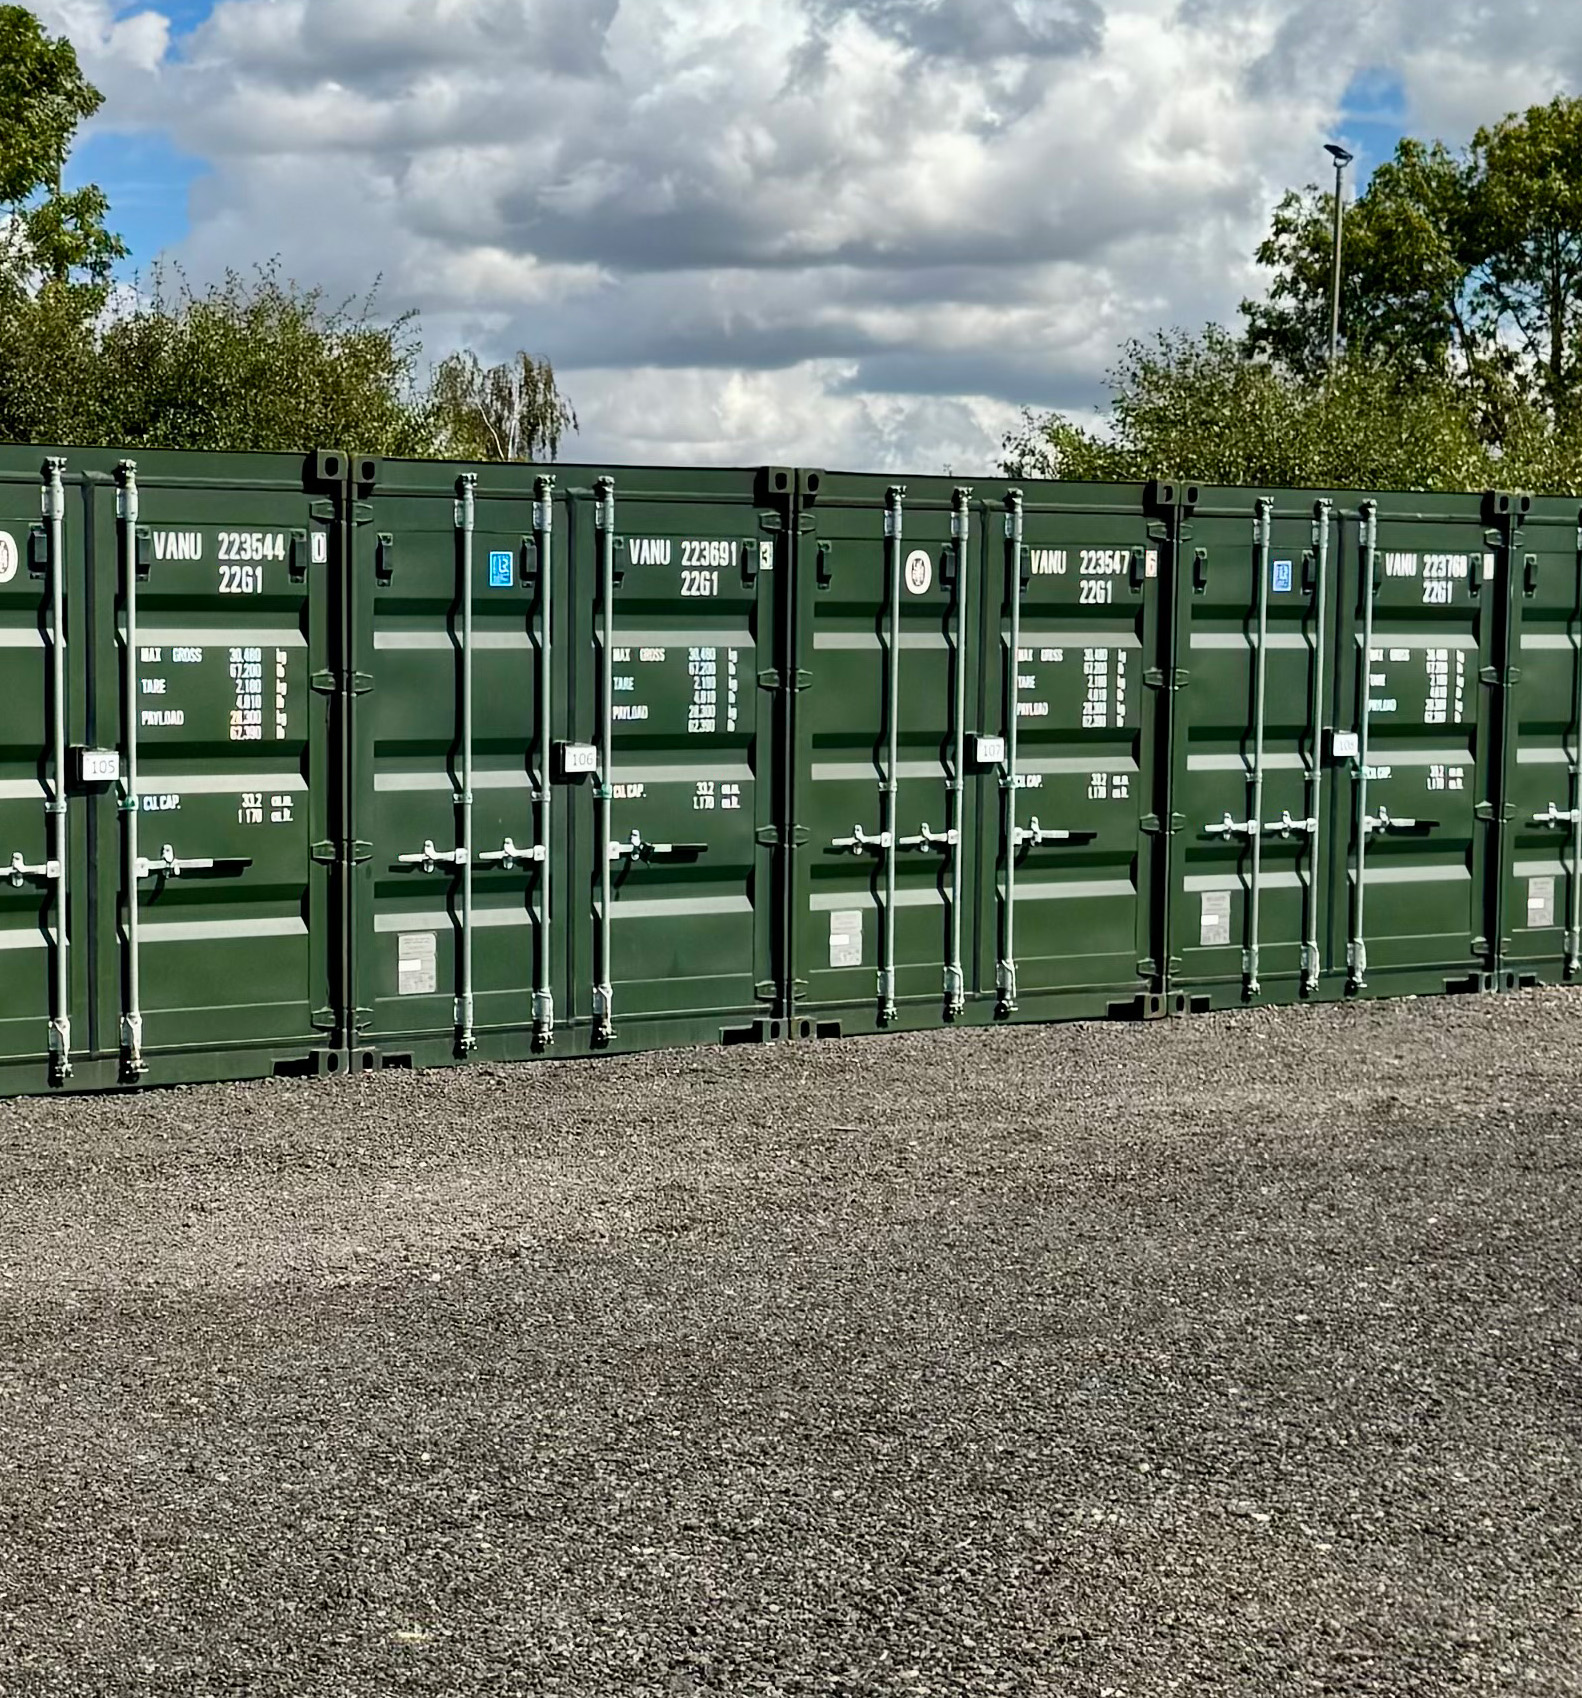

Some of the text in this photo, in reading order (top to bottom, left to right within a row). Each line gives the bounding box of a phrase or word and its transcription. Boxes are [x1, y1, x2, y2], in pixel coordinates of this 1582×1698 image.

[152, 532, 202, 560] VANU
[217, 532, 285, 561] 223544
[629, 539, 671, 566] VANU
[680, 540, 737, 567] 223691
[1030, 549, 1067, 575] VANU
[1079, 549, 1130, 575] 223547
[1385, 552, 1417, 577] VANU
[218, 566, 262, 594] 22G1
[680, 571, 719, 596] 22G1
[1079, 580, 1112, 604] 22G1
[1422, 579, 1453, 604] 22G1
[172, 647, 203, 662] GROSS
[141, 679, 166, 694] TARE
[141, 710, 185, 726] PAYLOAD
[572, 752, 594, 766] 106
[983, 744, 1001, 757] 107
[91, 759, 116, 774] 105
